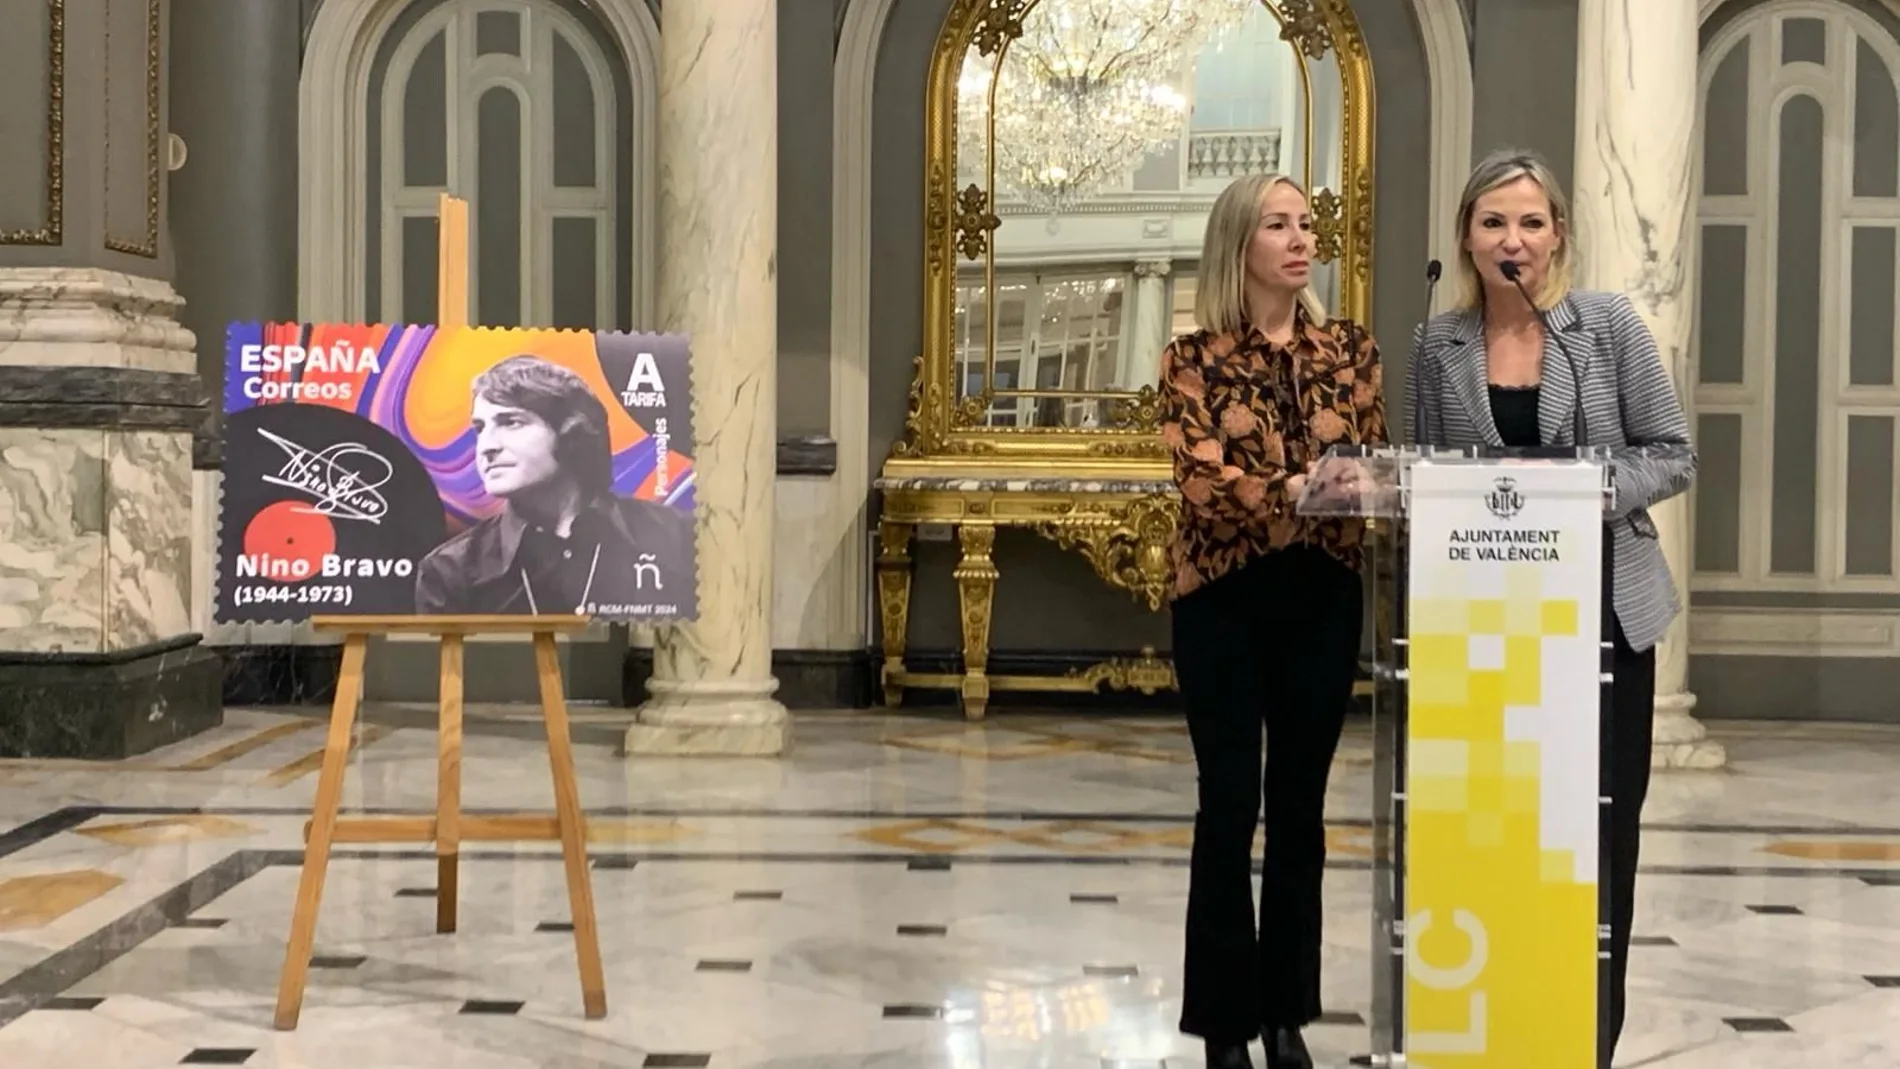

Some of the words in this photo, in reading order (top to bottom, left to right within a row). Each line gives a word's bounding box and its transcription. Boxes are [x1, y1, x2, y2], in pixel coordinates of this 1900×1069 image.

[240, 339, 381, 374] ESPAÑA
[627, 352, 666, 392] A
[243, 375, 353, 400] Correos
[621, 391, 667, 408] TARIFA
[652, 417, 671, 497] Personajes
[1449, 529, 1561, 544] AJUNTAMENT
[235, 552, 311, 578] Nino
[321, 553, 413, 578] Bravo
[1449, 547, 1471, 561] DE
[1476, 543, 1561, 562] VALÈNCIA
[633, 552, 664, 590] ñ
[233, 585, 354, 607] (1944-1973)
[1404, 907, 1489, 1069] LC
